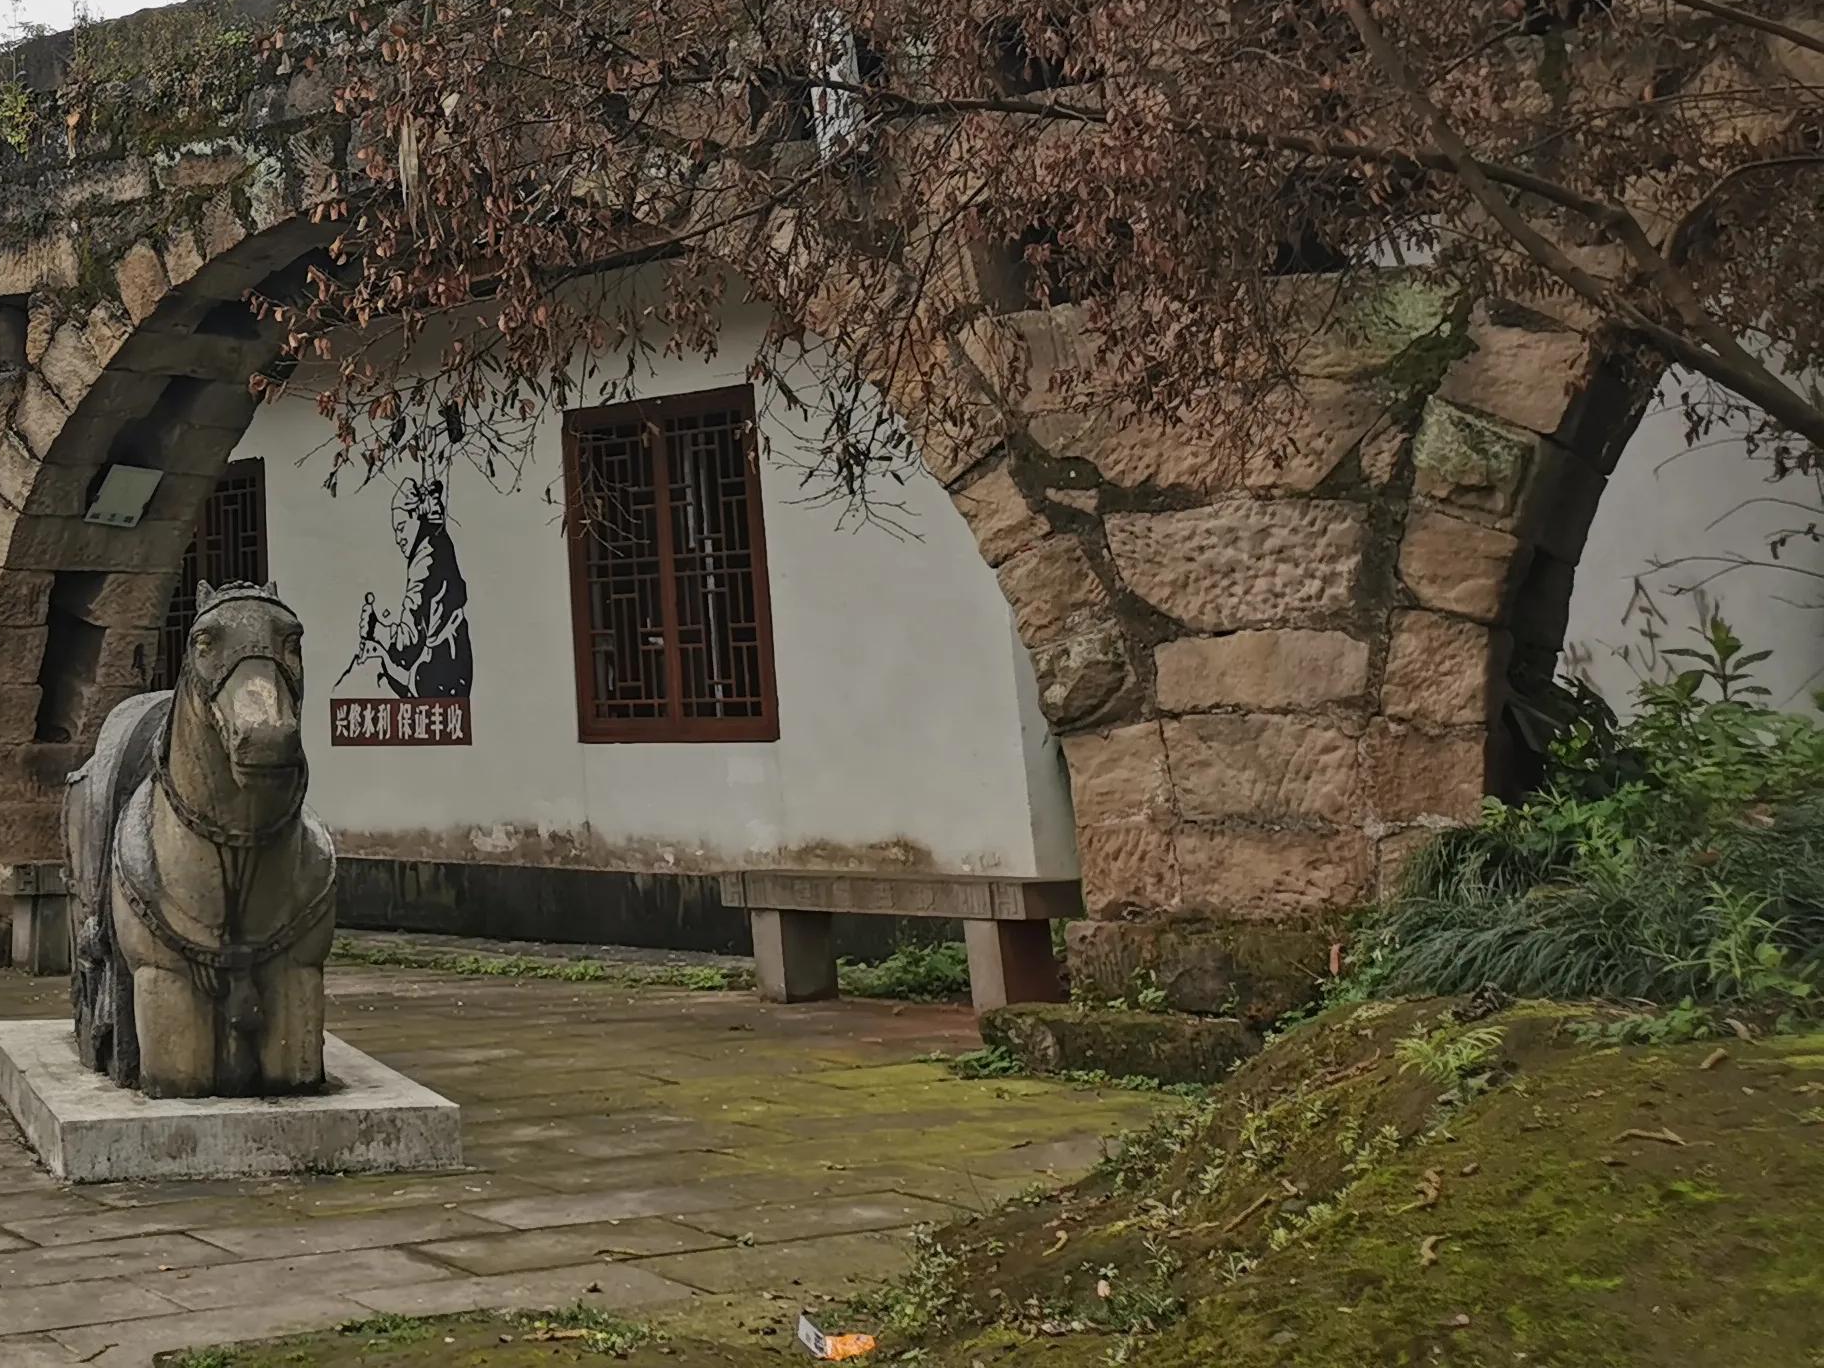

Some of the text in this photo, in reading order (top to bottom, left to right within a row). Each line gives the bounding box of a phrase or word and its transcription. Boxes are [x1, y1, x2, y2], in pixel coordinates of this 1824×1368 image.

[336, 703, 464, 741] 兴修水利 保证丰收
